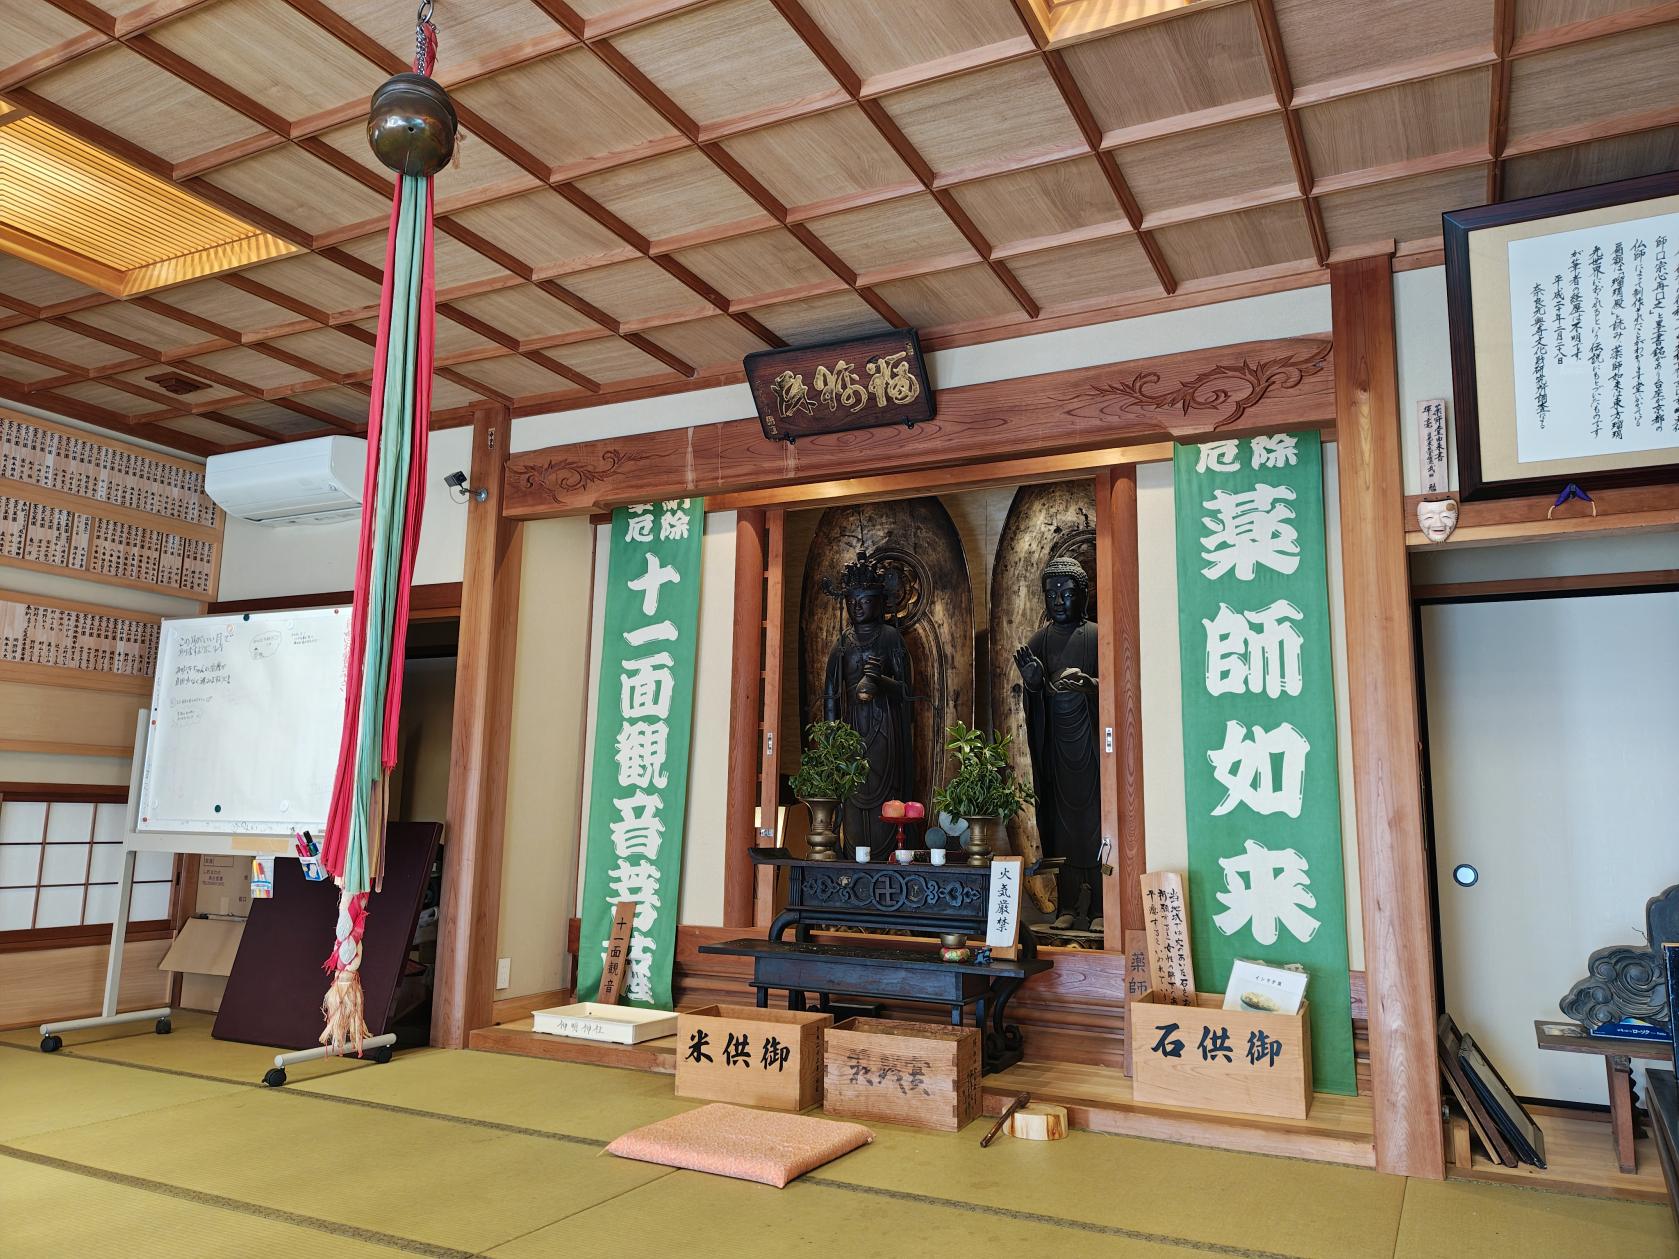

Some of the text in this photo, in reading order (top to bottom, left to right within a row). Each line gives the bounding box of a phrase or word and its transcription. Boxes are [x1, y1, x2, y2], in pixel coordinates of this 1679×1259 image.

[1200, 482, 1322, 947] 薬師如来
[995, 867, 1013, 933] 火気厳禁
[604, 917, 628, 993] 十一面観音
